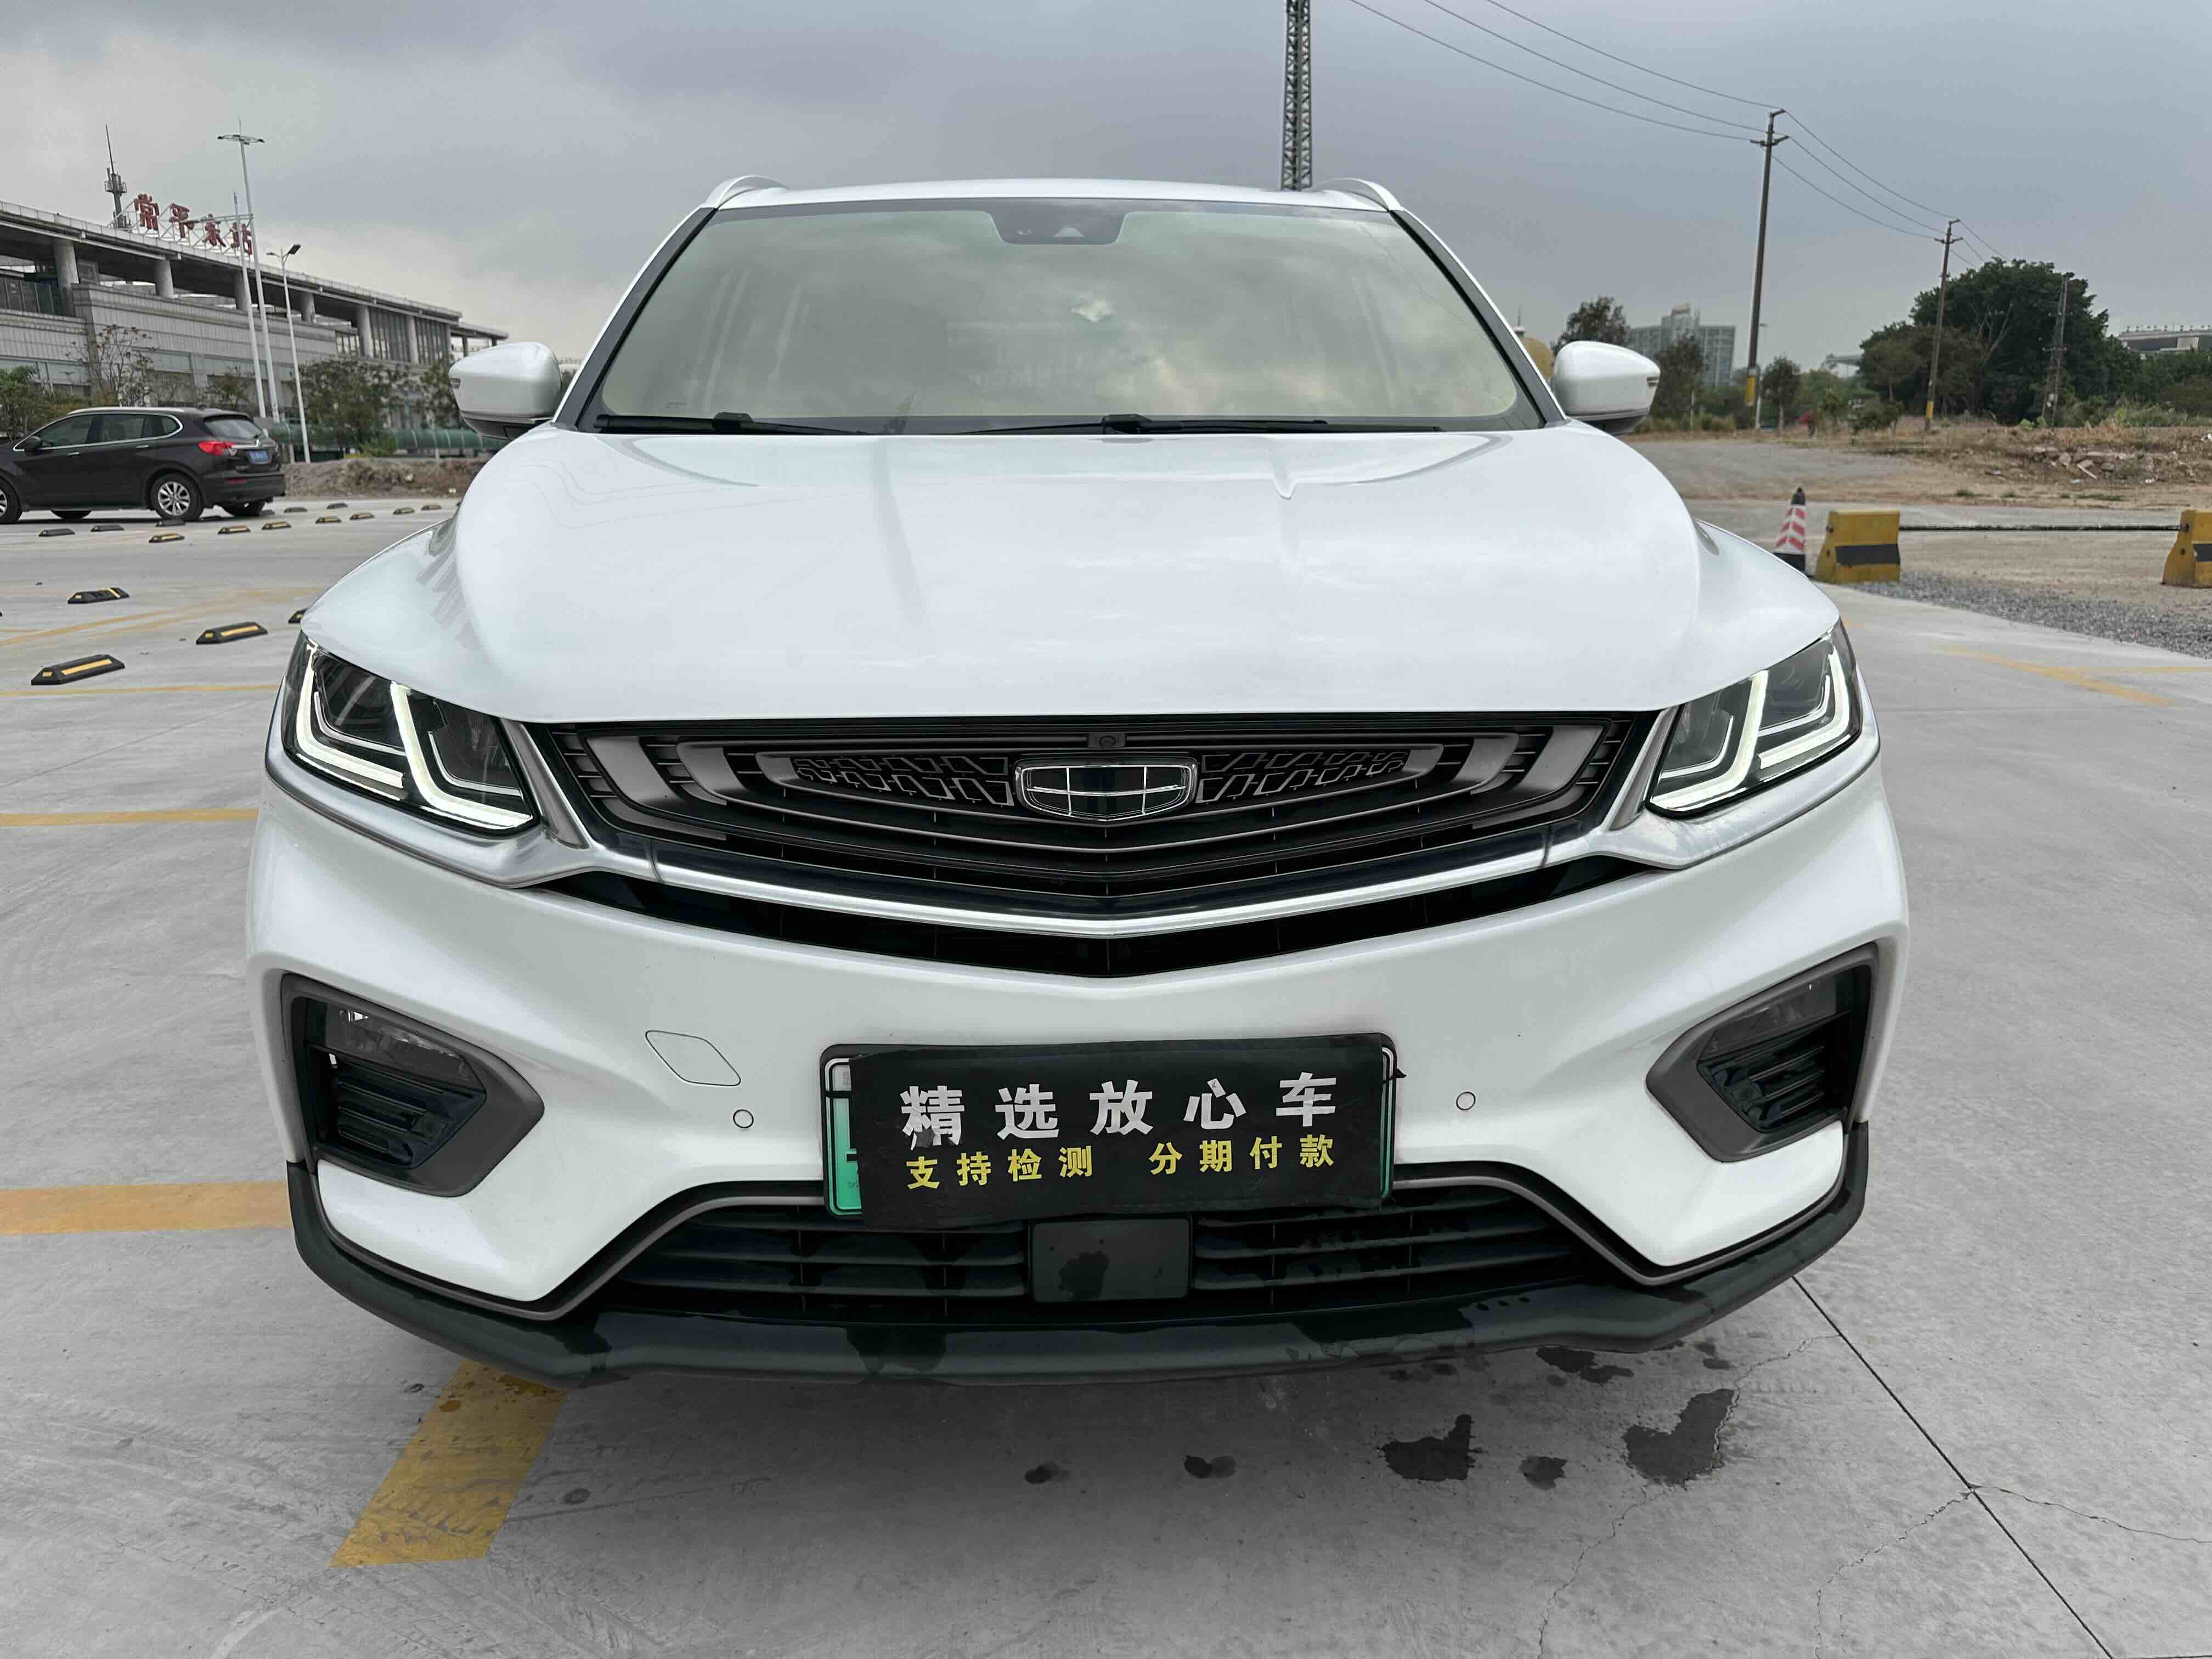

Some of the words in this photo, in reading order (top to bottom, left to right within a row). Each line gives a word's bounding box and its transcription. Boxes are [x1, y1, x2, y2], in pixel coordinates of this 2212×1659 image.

[900, 1072, 1337, 1151] 精选放心车
[906, 1146, 1093, 1189] 支持检测
[1150, 1134, 1334, 1175] 分期付款
